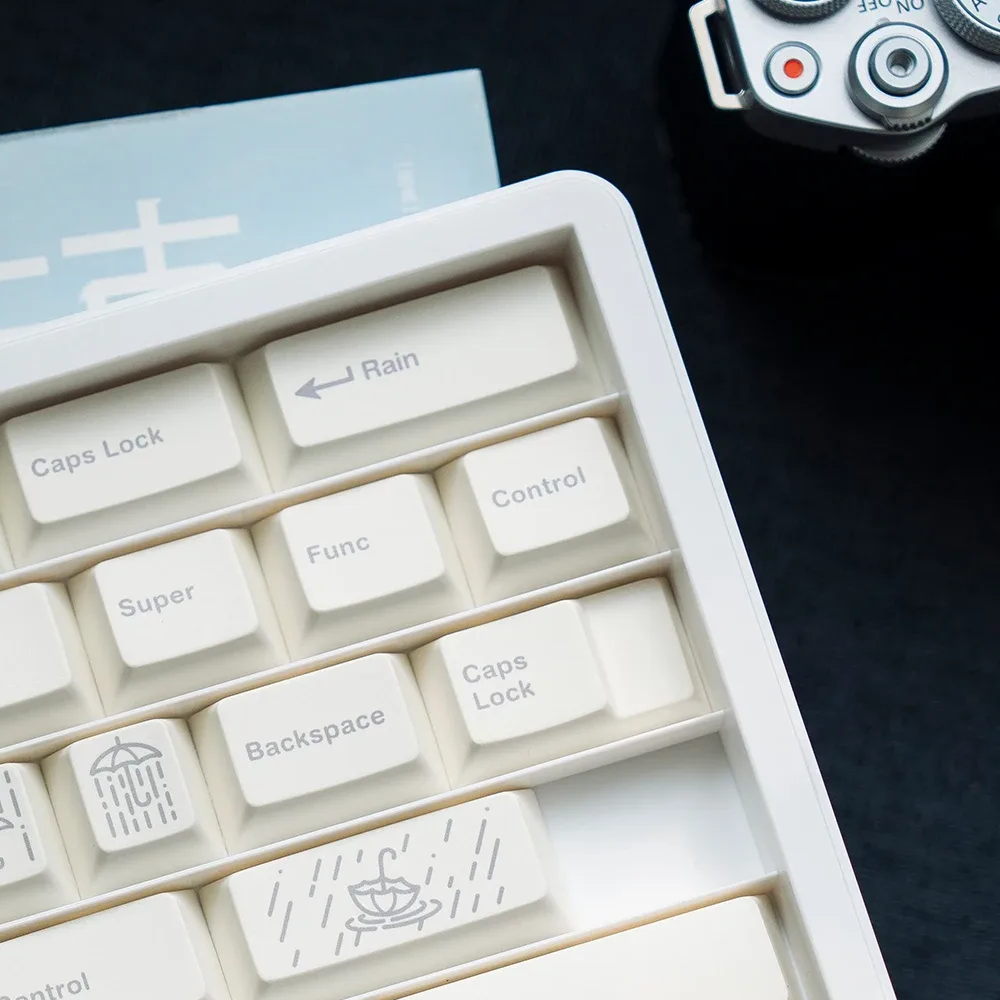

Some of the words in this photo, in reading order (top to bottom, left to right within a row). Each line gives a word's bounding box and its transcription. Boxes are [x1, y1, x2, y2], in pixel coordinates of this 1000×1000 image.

[896, 0, 924, 14] ON
[360, 352, 420, 381] Rain
[30, 449, 96, 478] Caps
[102, 426, 165, 458] Lock
[491, 465, 587, 508] Control
[306, 536, 370, 564] Func
[117, 585, 195, 618] Super
[462, 654, 530, 685] Caps
[472, 678, 536, 711] Lock
[244, 709, 386, 762] Backspace
